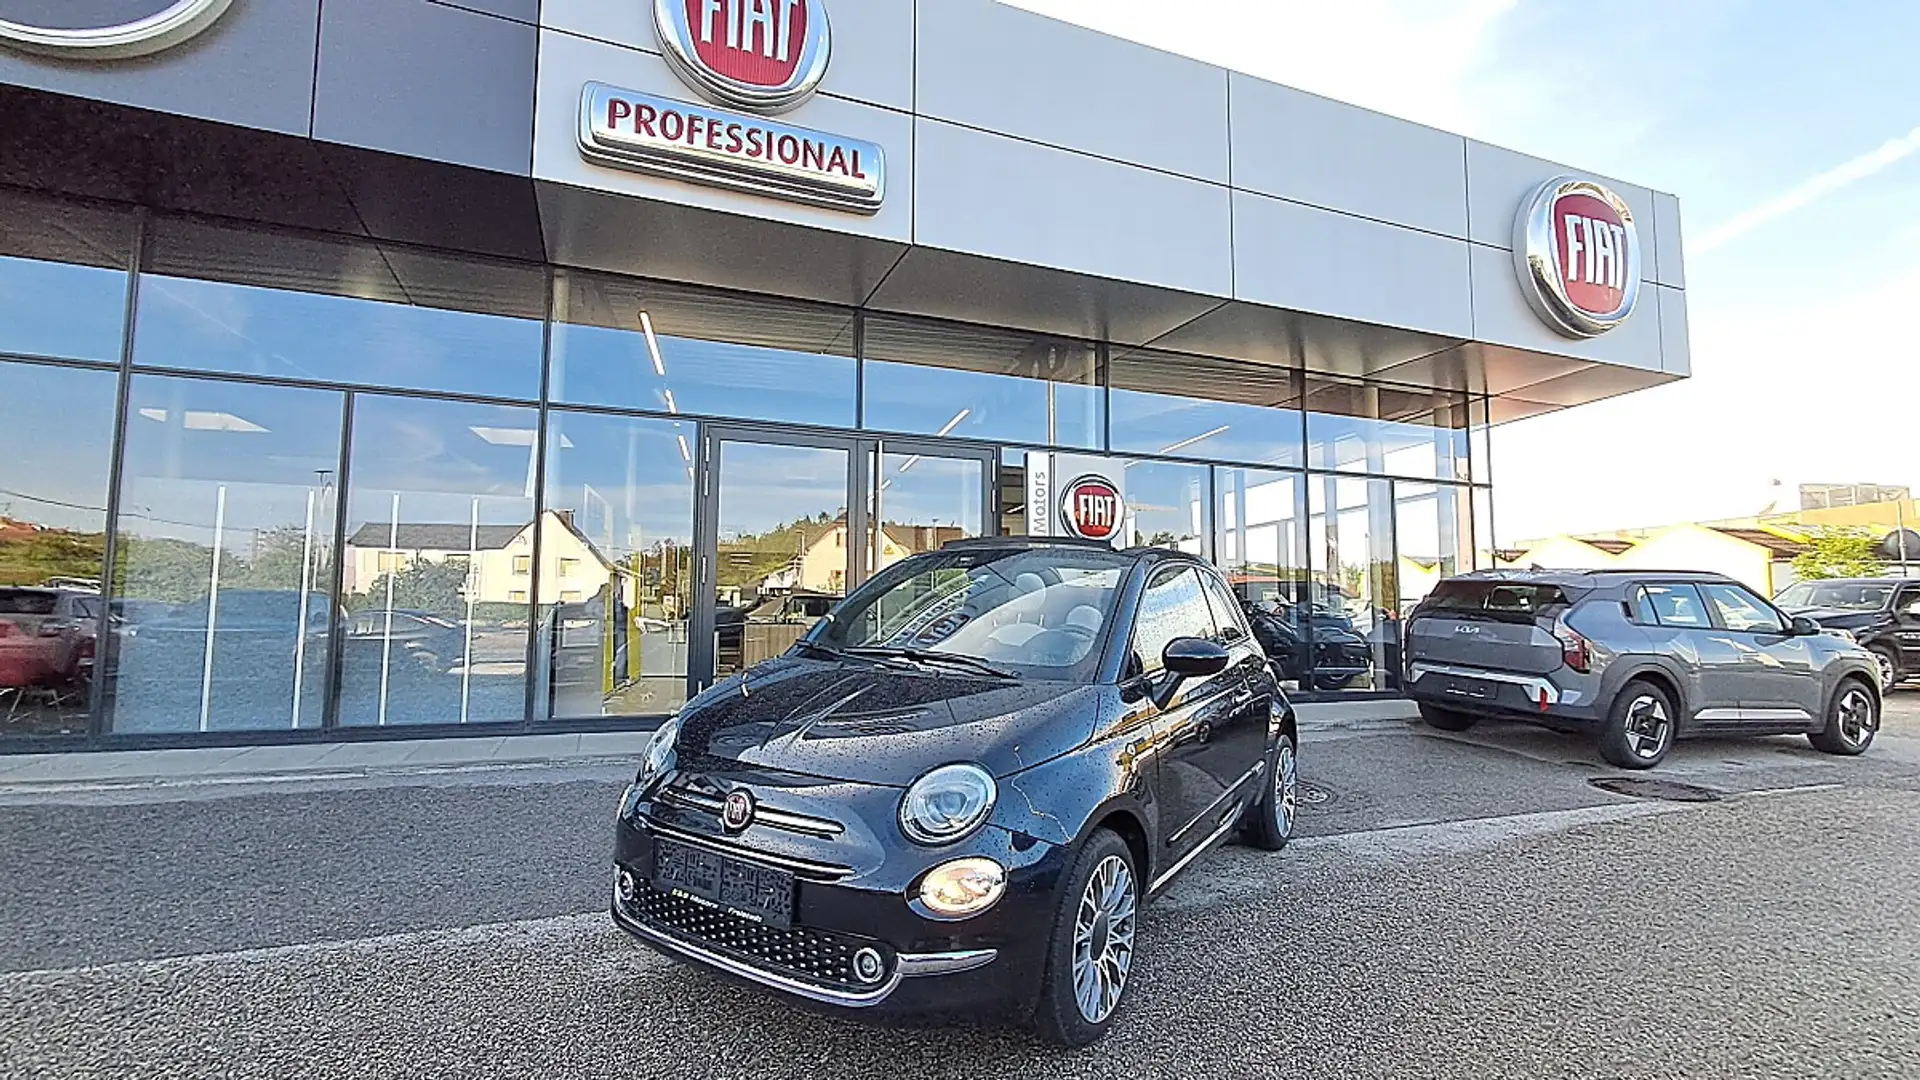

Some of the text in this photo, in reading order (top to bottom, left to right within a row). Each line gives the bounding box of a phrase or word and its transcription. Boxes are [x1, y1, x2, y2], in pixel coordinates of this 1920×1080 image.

[700, 0, 799, 62] FIAT
[606, 98, 866, 180] PROFESSIONAL
[1564, 213, 1624, 290] FIAT
[1033, 471, 1047, 534] Motors
[1078, 494, 1115, 527] FIAT
